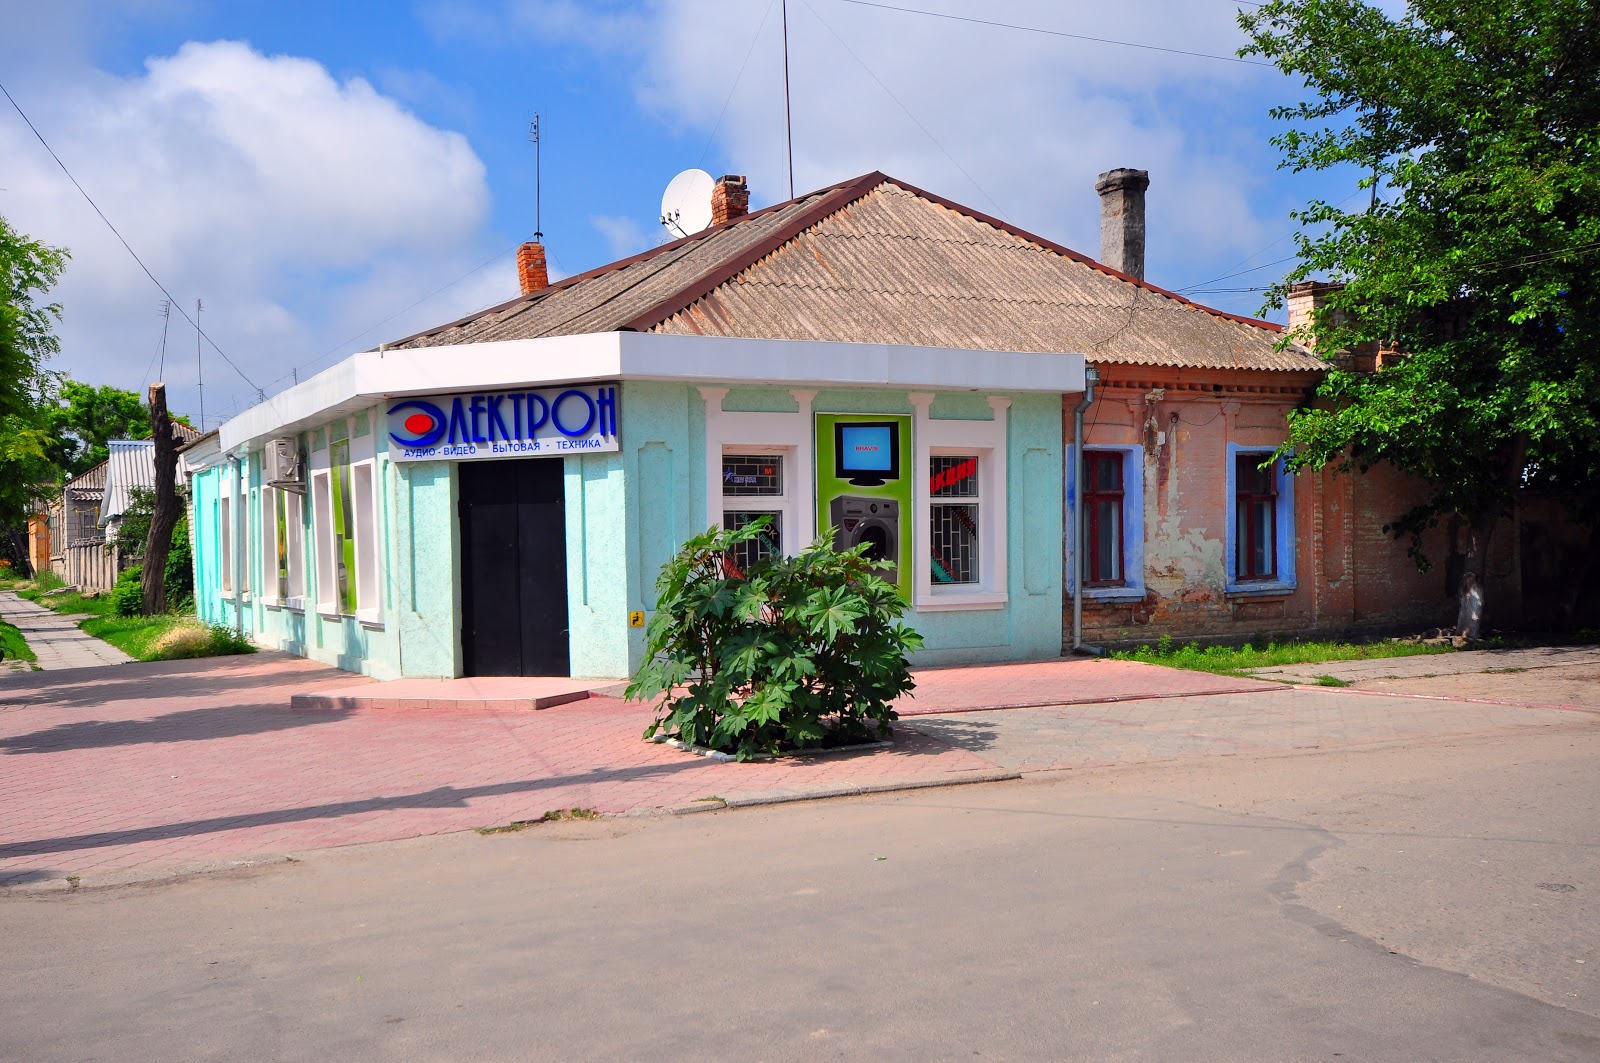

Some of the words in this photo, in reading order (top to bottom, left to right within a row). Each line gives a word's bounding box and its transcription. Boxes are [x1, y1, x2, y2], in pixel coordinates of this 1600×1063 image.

[386, 388, 616, 447] ЭЛЕКТРОН
[404, 446, 436, 458] АУДИО
[443, 445, 476, 456] ВИДЕО
[492, 442, 541, 453] БЫТОВАЯ
[556, 439, 601, 450] ТЕХНИКА
